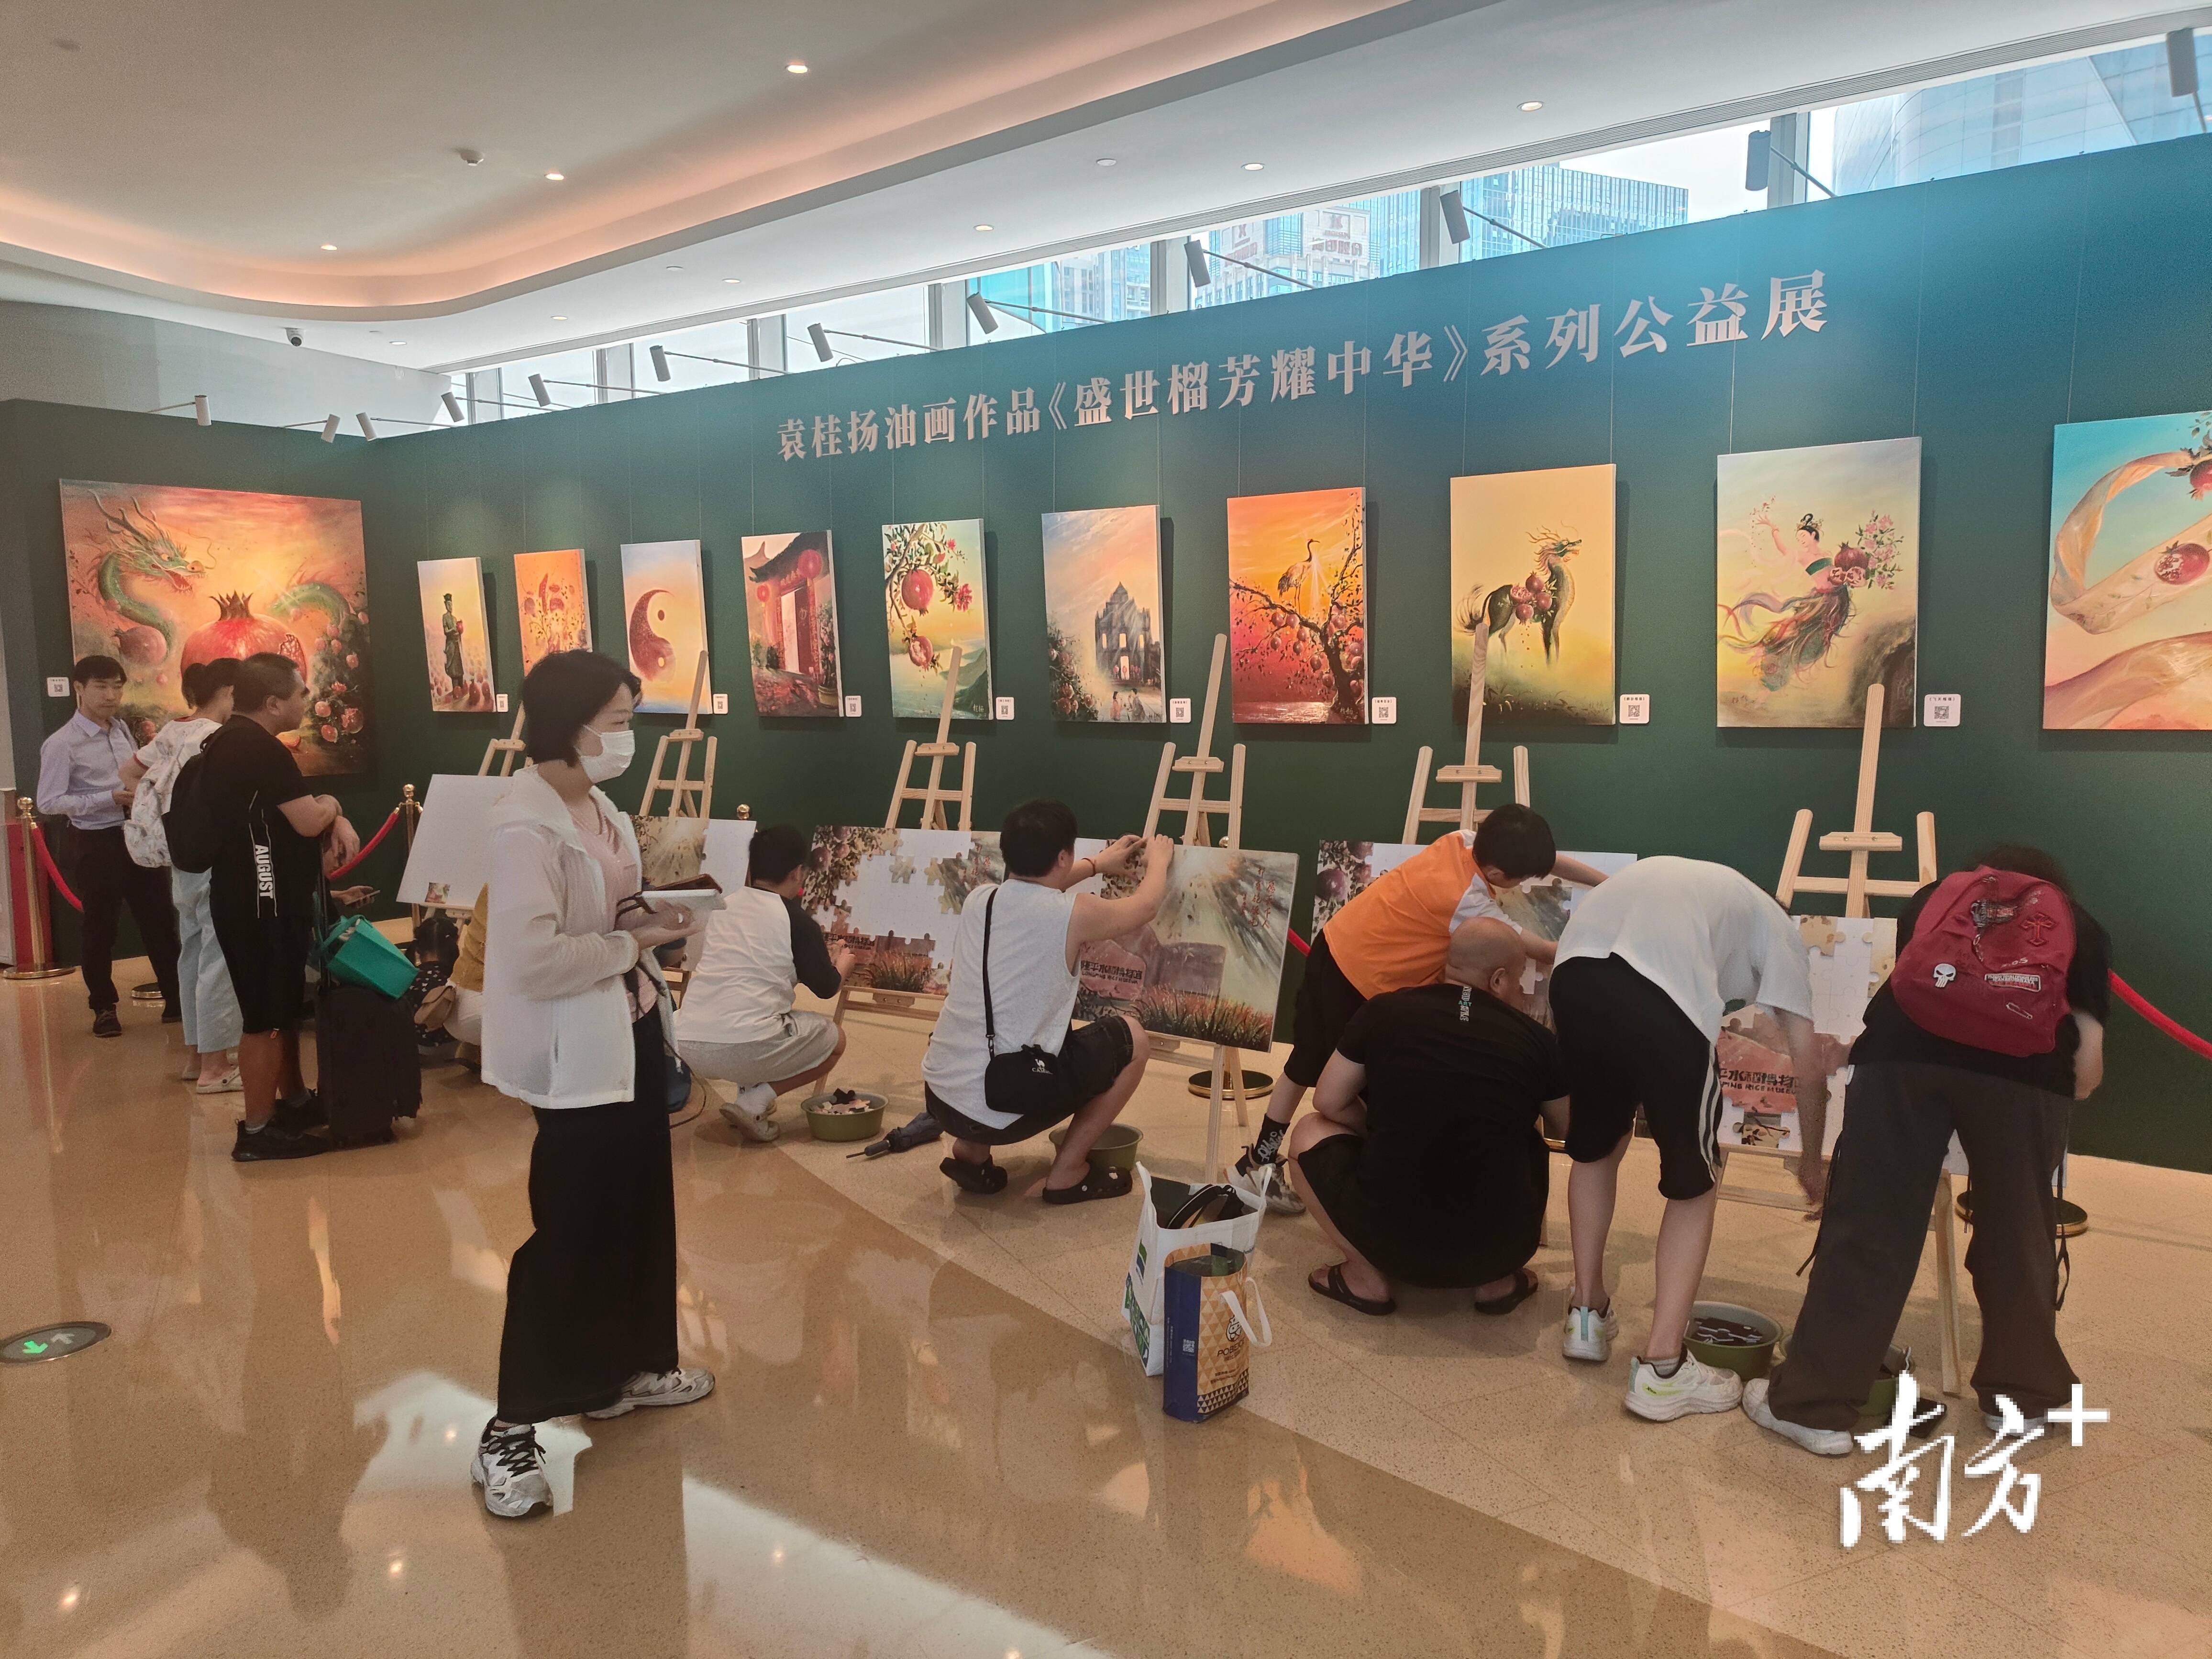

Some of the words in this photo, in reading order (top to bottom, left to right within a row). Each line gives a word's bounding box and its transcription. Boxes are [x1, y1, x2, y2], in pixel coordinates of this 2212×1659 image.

[776, 269, 1828, 462] 袁桂扬油画作品《盛世榴芳耀中华》系列公益展
[254, 844, 274, 899] AUGUST
[1767, 1086, 1797, 1095] MUSEU
